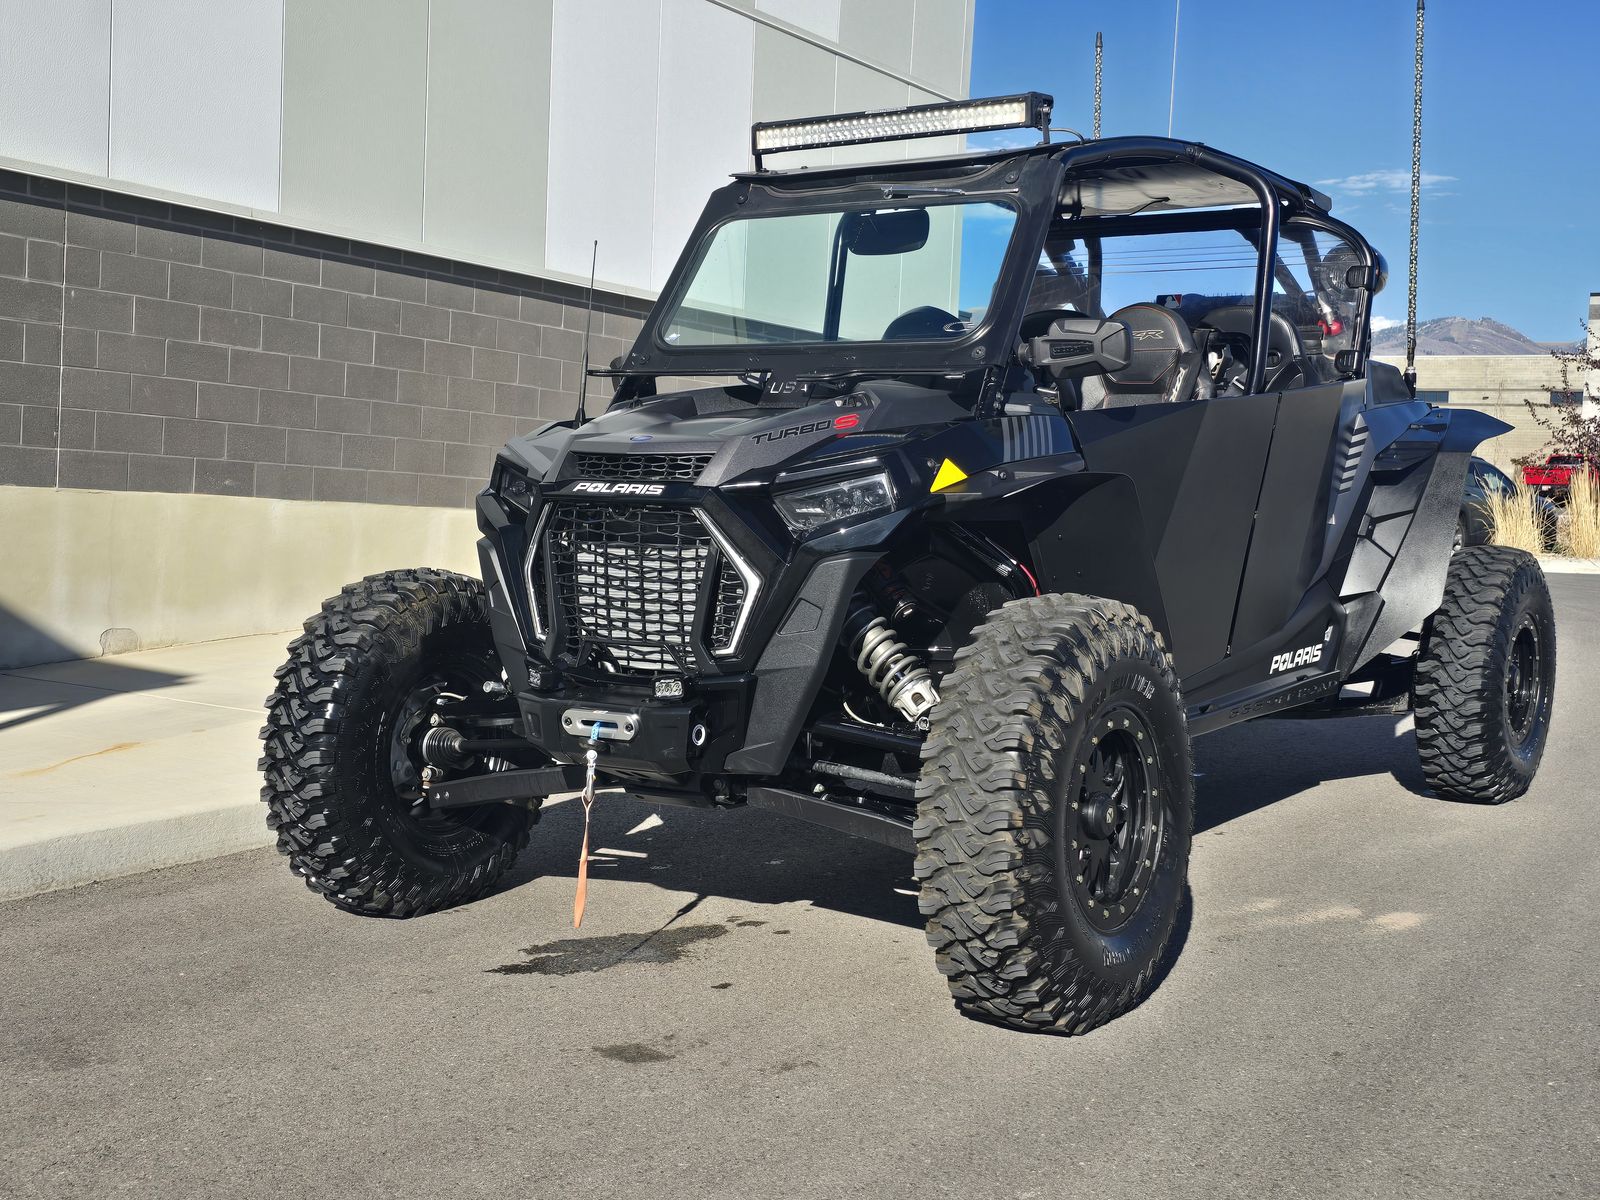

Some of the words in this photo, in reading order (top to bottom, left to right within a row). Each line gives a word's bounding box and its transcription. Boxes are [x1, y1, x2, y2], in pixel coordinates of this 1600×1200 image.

[751, 419, 832, 445] TURBO
[832, 413, 860, 430] S
[572, 482, 665, 496] POLARIS
[1269, 643, 1323, 675] POLARIS
